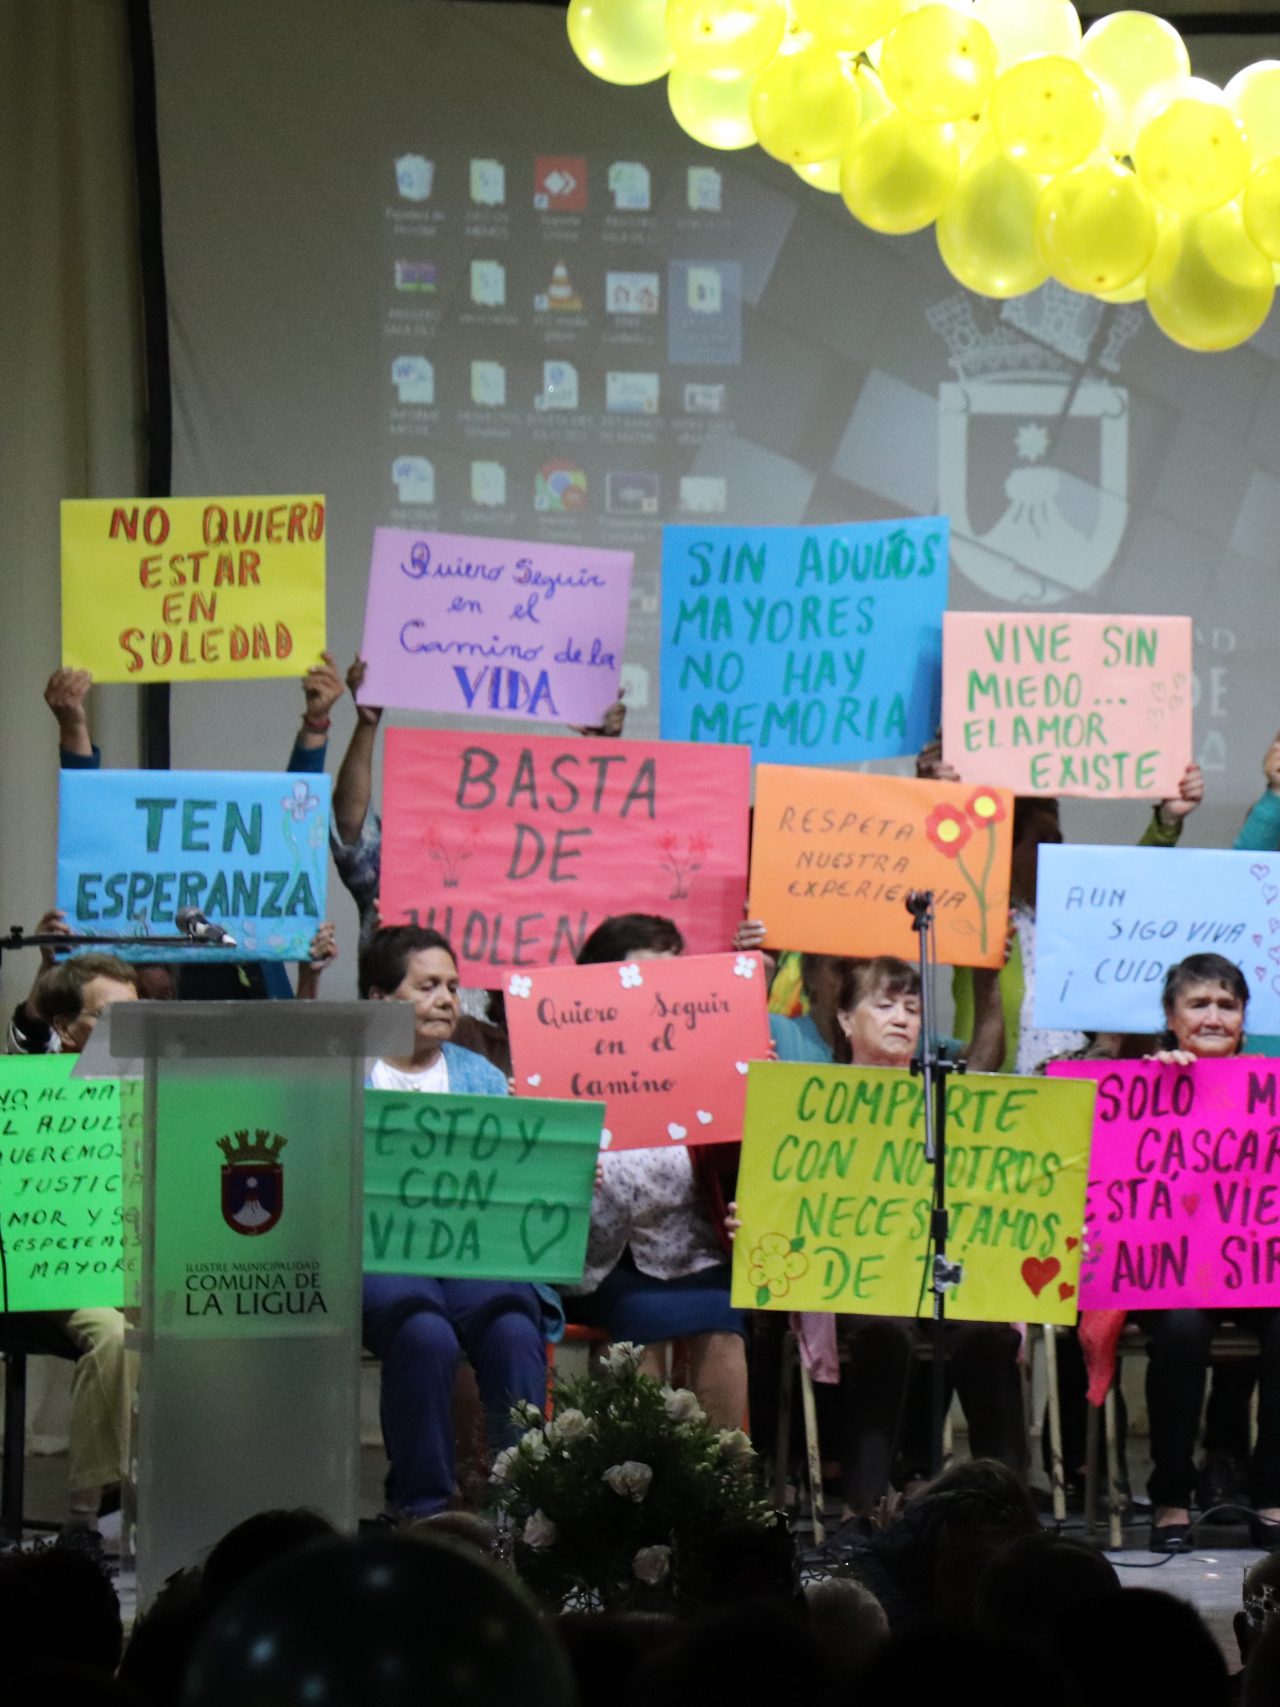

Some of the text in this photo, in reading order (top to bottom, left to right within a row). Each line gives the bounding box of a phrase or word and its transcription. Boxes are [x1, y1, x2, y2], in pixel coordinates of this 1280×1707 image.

[109, 501, 325, 545] NO QUIERO
[140, 549, 262, 589] ESTAR
[401, 541, 606, 599] Quiero Seguir
[688, 540, 766, 588] SIN
[162, 591, 217, 625] EN
[447, 592, 541, 623] en el
[673, 595, 876, 646] MAYORES
[120, 622, 293, 672] SOLEDAD
[400, 619, 543, 661] Camino
[984, 622, 1072, 666] VIVE
[1101, 626, 1160, 668] SIN
[453, 665, 560, 717] VIDA
[680, 647, 867, 697] NO HAY
[690, 693, 908, 747] MEMORIA
[455, 747, 658, 819] BASTA
[1030, 750, 1162, 790] EXISTE
[135, 798, 263, 855] TEN
[779, 805, 915, 841] RESPETA
[507, 823, 592, 883] DE
[796, 850, 910, 874] NUESTRA
[76, 870, 319, 922] ESPERANZA
[788, 880, 967, 909] EXPERIEIA
[1065, 886, 1126, 909] AUN
[1109, 919, 1246, 944] SIGO VIVA
[538, 991, 731, 1031] Quiero Seguir
[595, 1023, 676, 1057] en el
[571, 1071, 676, 1095] Camino
[1100, 1073, 1195, 1123] SOLO
[773, 1135, 1060, 1198] CON NOOTROS
[400, 1167, 497, 1212] CON
[368, 1212, 480, 1261] VIDA
[795, 1195, 1060, 1256] NECESTAMOS
[185, 1261, 320, 1272] ILUSTRE MUNICIPALIDAD
[185, 1273, 322, 1292] COMUNA DE
[818, 1247, 884, 1301] DE
[1112, 1235, 1189, 1293] AUN
[186, 1291, 329, 1316] LA LIGUA
